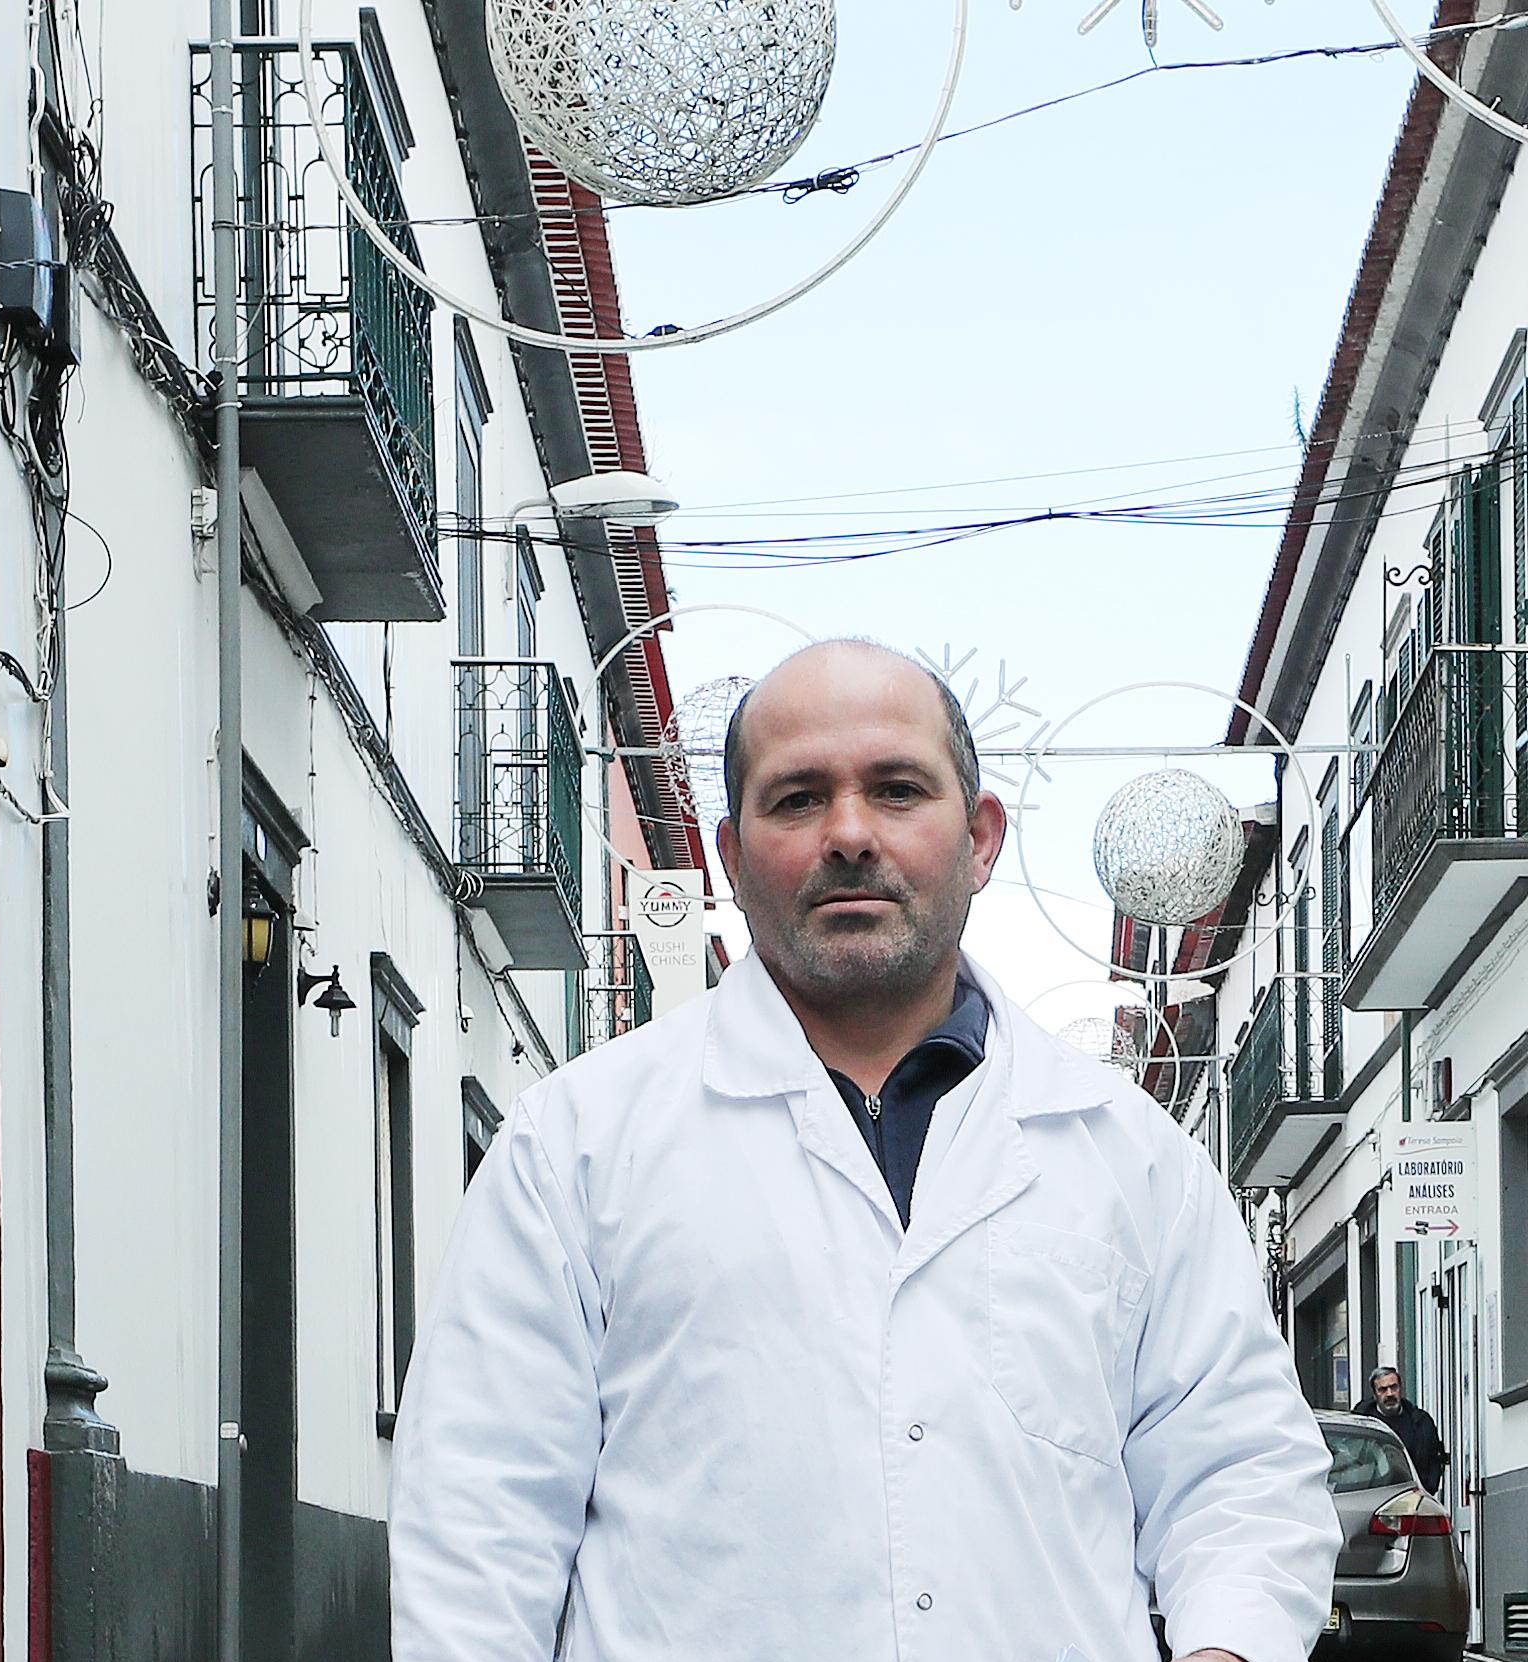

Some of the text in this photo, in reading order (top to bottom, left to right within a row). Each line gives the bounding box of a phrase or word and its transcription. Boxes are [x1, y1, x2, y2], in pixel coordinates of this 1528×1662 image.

[640, 901, 691, 912] YUMMY
[649, 942, 685, 953] SUSHI
[1398, 1160, 1464, 1175] LABORATÓRIO
[1408, 1183, 1455, 1198] ANÁLISES
[1405, 1205, 1459, 1215] ENTRADA
